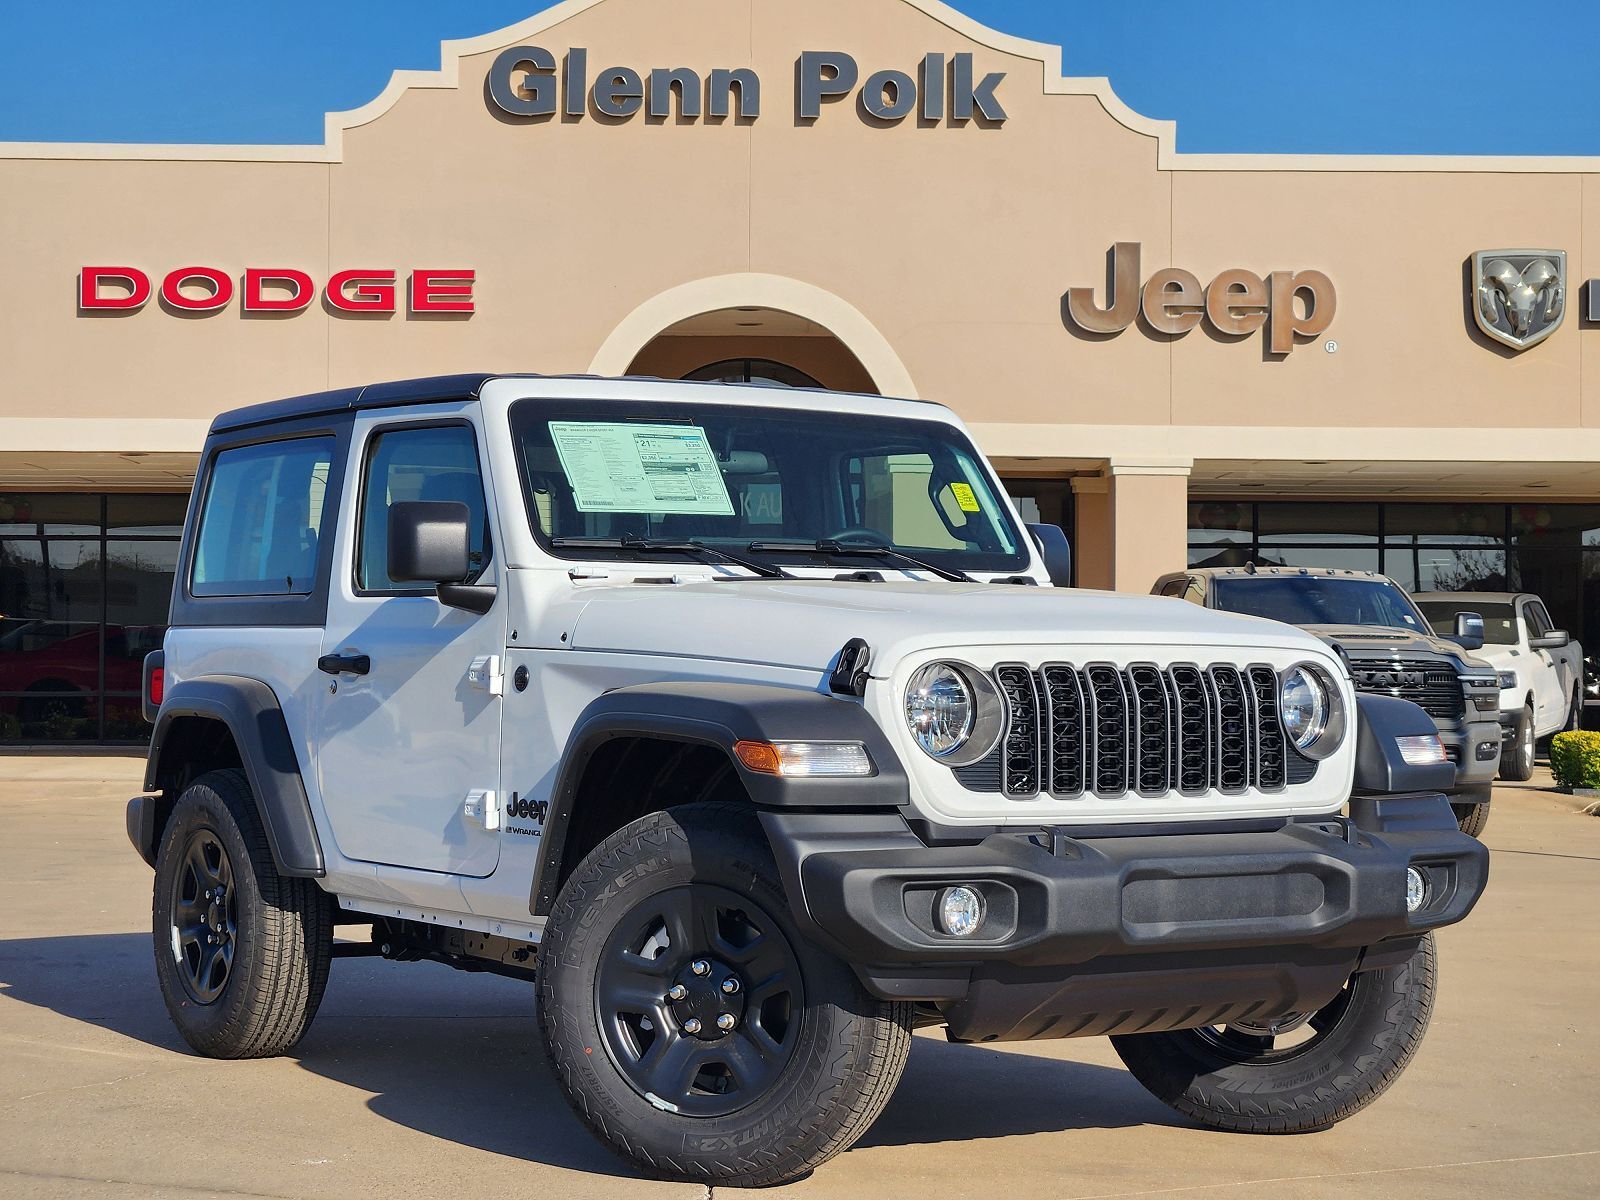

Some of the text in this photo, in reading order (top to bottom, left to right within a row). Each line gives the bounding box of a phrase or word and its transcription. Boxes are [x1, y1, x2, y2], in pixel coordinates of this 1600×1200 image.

[489, 46, 1009, 120] Glenn Polk
[80, 266, 476, 313] DODGE
[1066, 241, 1337, 354] Jeep
[506, 791, 549, 826] Jeep
[567, 857, 660, 954] NEXEN
